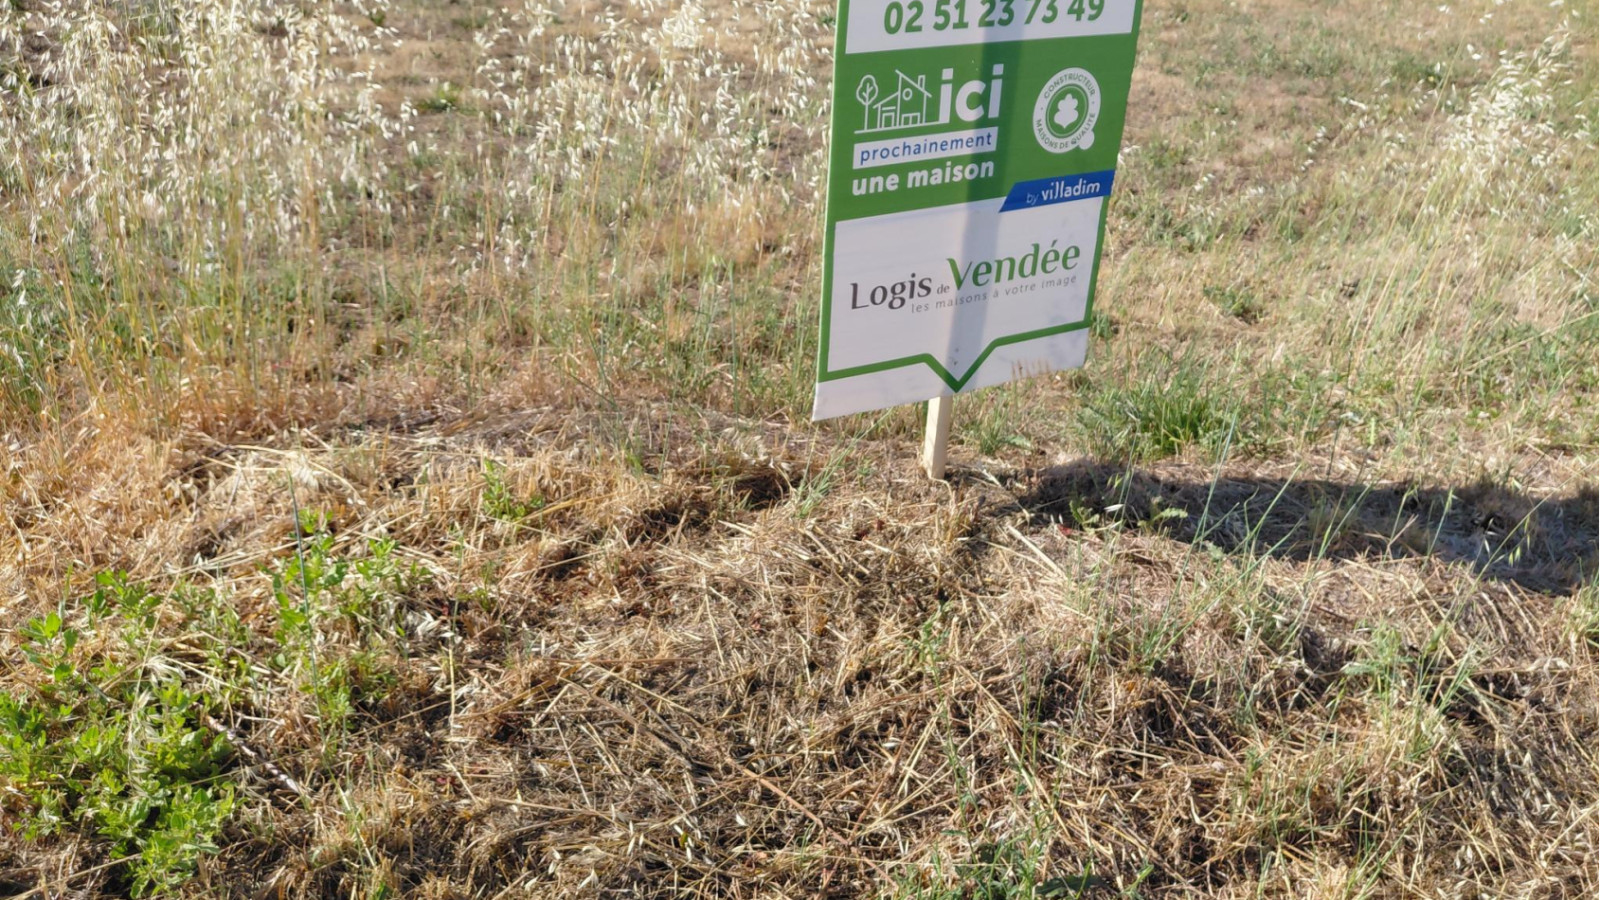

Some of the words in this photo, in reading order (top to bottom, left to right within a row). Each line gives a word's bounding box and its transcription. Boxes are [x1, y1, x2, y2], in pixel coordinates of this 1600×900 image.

[884, 1, 924, 35] 02
[933, 0, 969, 31] 51
[978, 0, 1015, 28] 23
[1024, 0, 1059, 24] 73
[1067, 0, 1105, 21] 49
[939, 63, 1005, 123] ici
[1043, 72, 1096, 99] CONSTRUCTEUR
[859, 132, 993, 165] prochainement
[1035, 118, 1058, 149] MAISONS
[1059, 140, 1069, 149] DE
[852, 173, 899, 196] une
[907, 161, 995, 189] maison
[1026, 193, 1039, 205] by
[1041, 180, 1101, 201] villadim
[850, 272, 932, 310] Logis
[936, 283, 950, 295] de
[947, 240, 1081, 291] Vendée
[911, 303, 930, 313] les
[935, 292, 988, 310] maisons
[992, 287, 999, 298] à
[1004, 284, 1036, 297] votre
[1041, 274, 1077, 288] image
